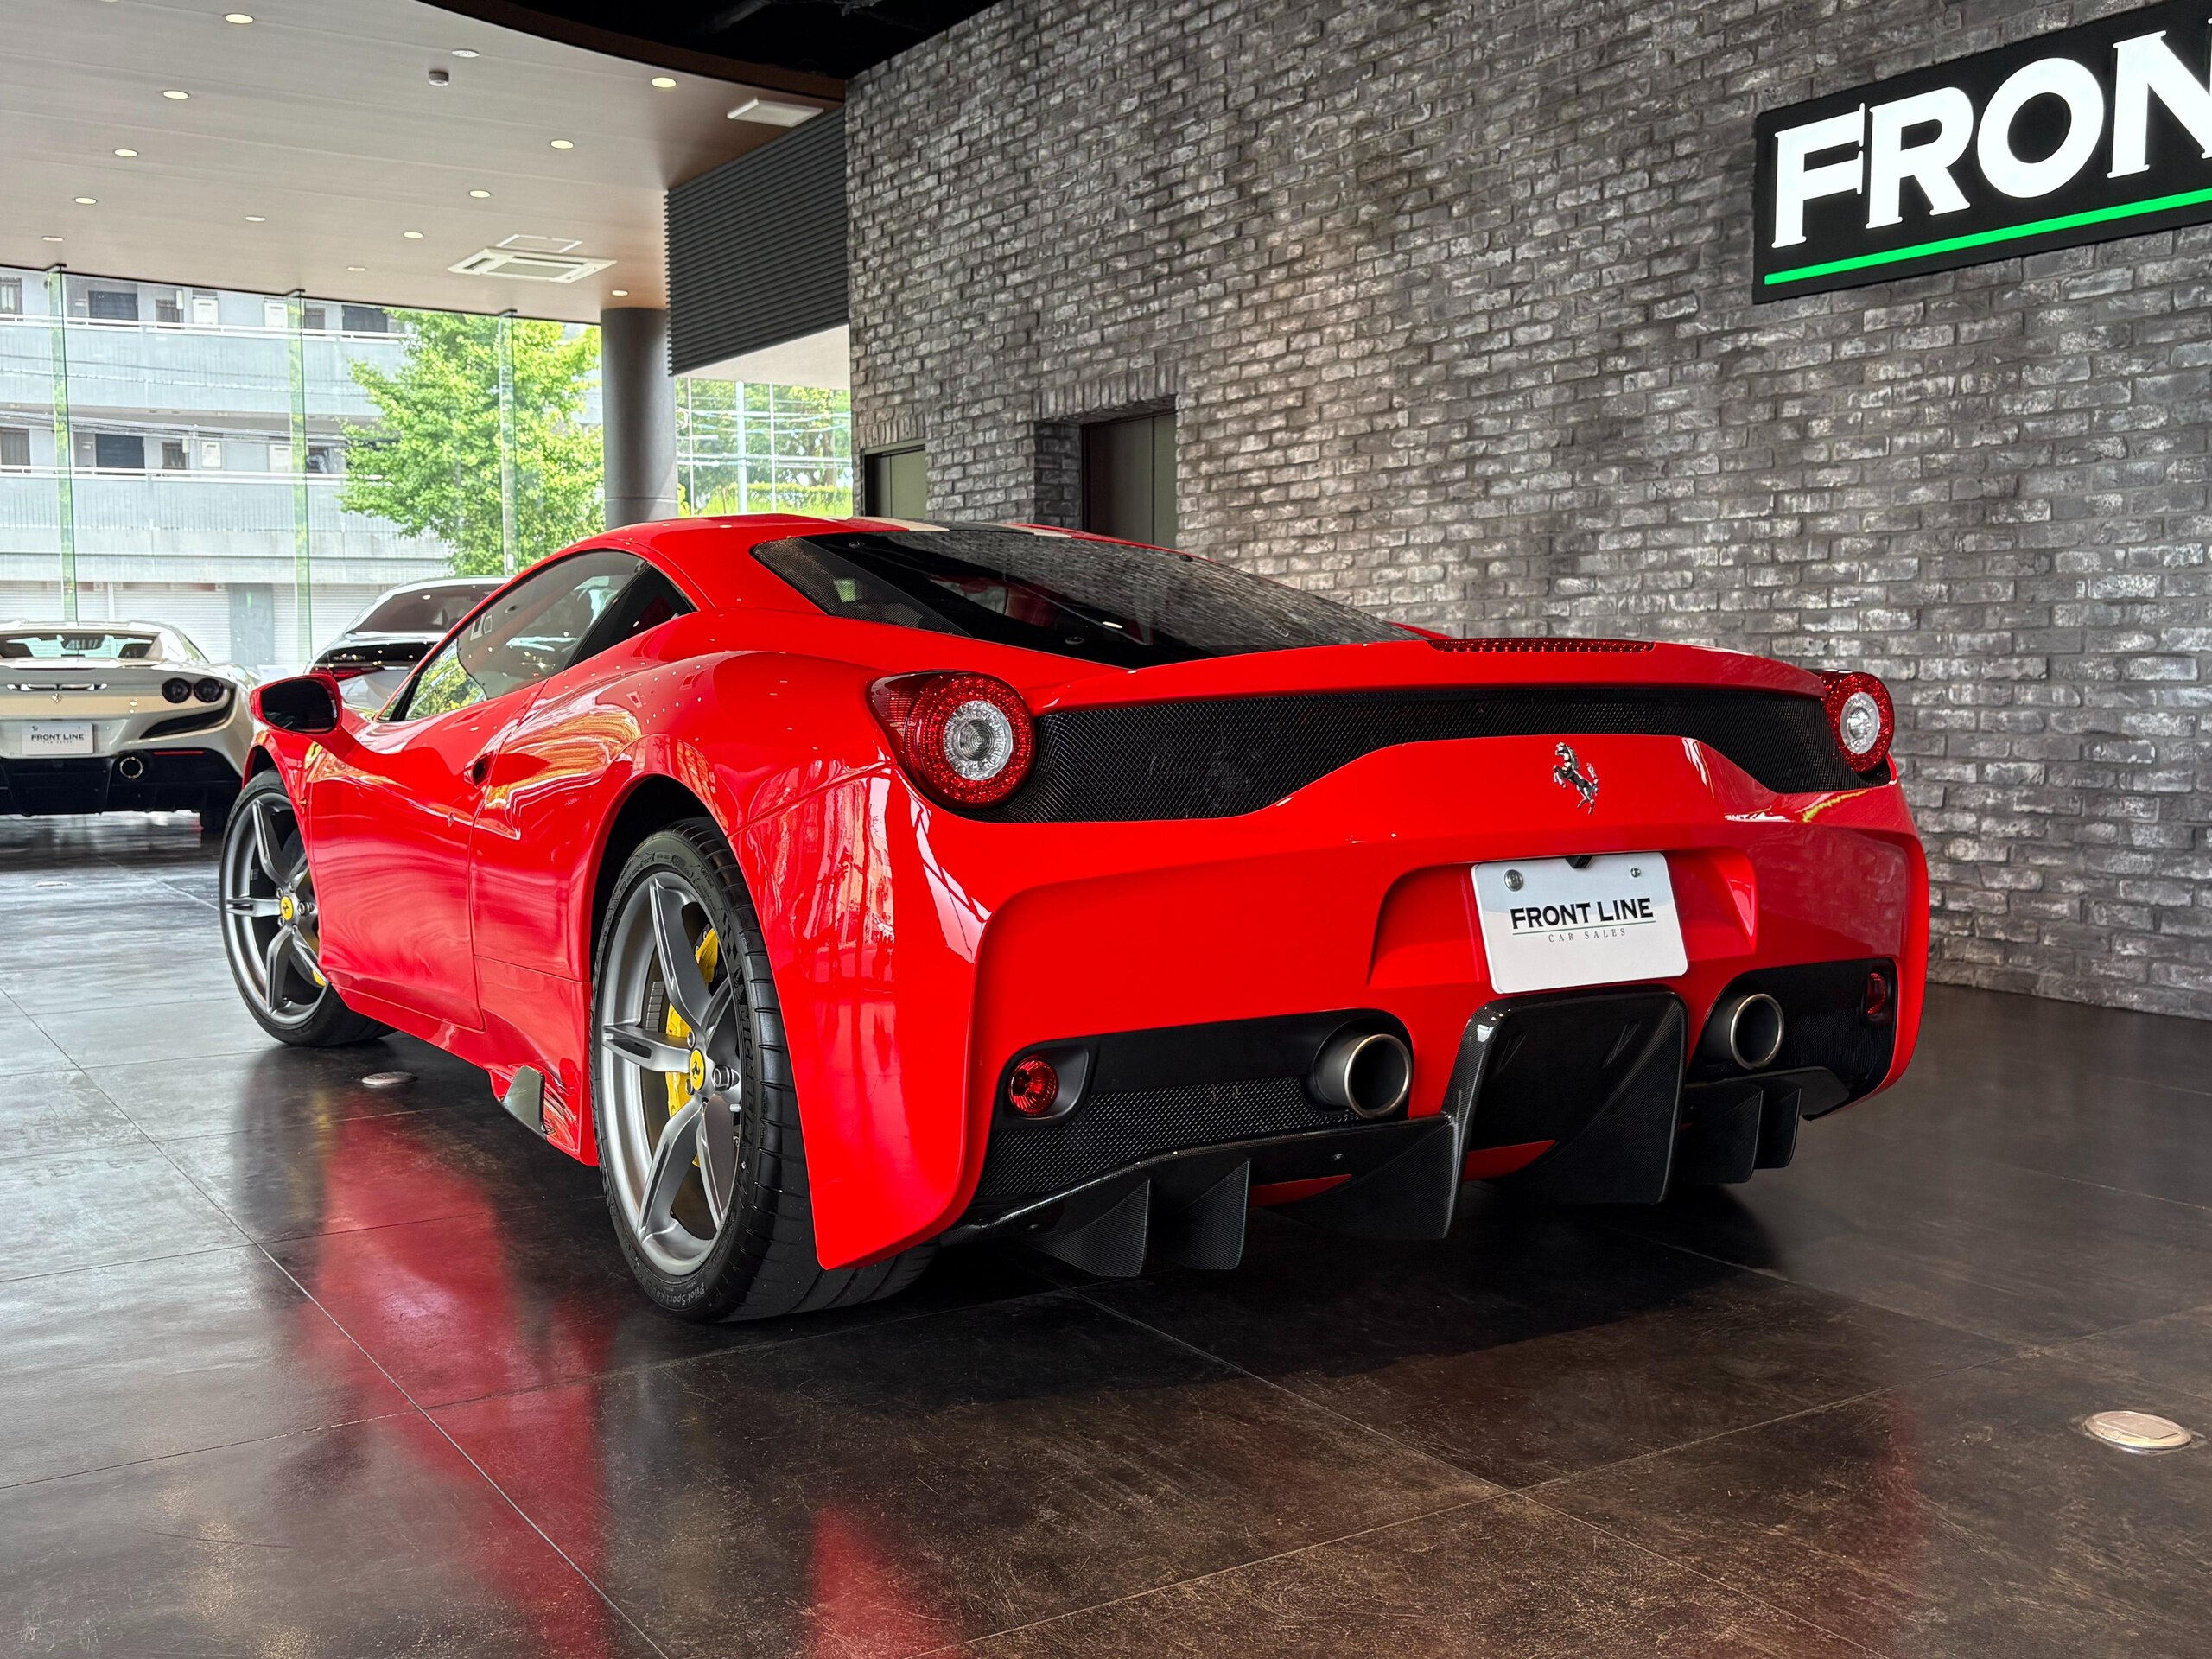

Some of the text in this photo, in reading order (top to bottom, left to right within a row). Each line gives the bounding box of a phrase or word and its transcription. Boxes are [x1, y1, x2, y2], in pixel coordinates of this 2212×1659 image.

[1510, 897, 1654, 930] FRONT LINE
[1548, 927, 1626, 943] CAR SALES
[740, 1004, 755, 1139] MICHELIN
[666, 1293, 686, 1306] Sport
[688, 1282, 705, 1303] Pilot
